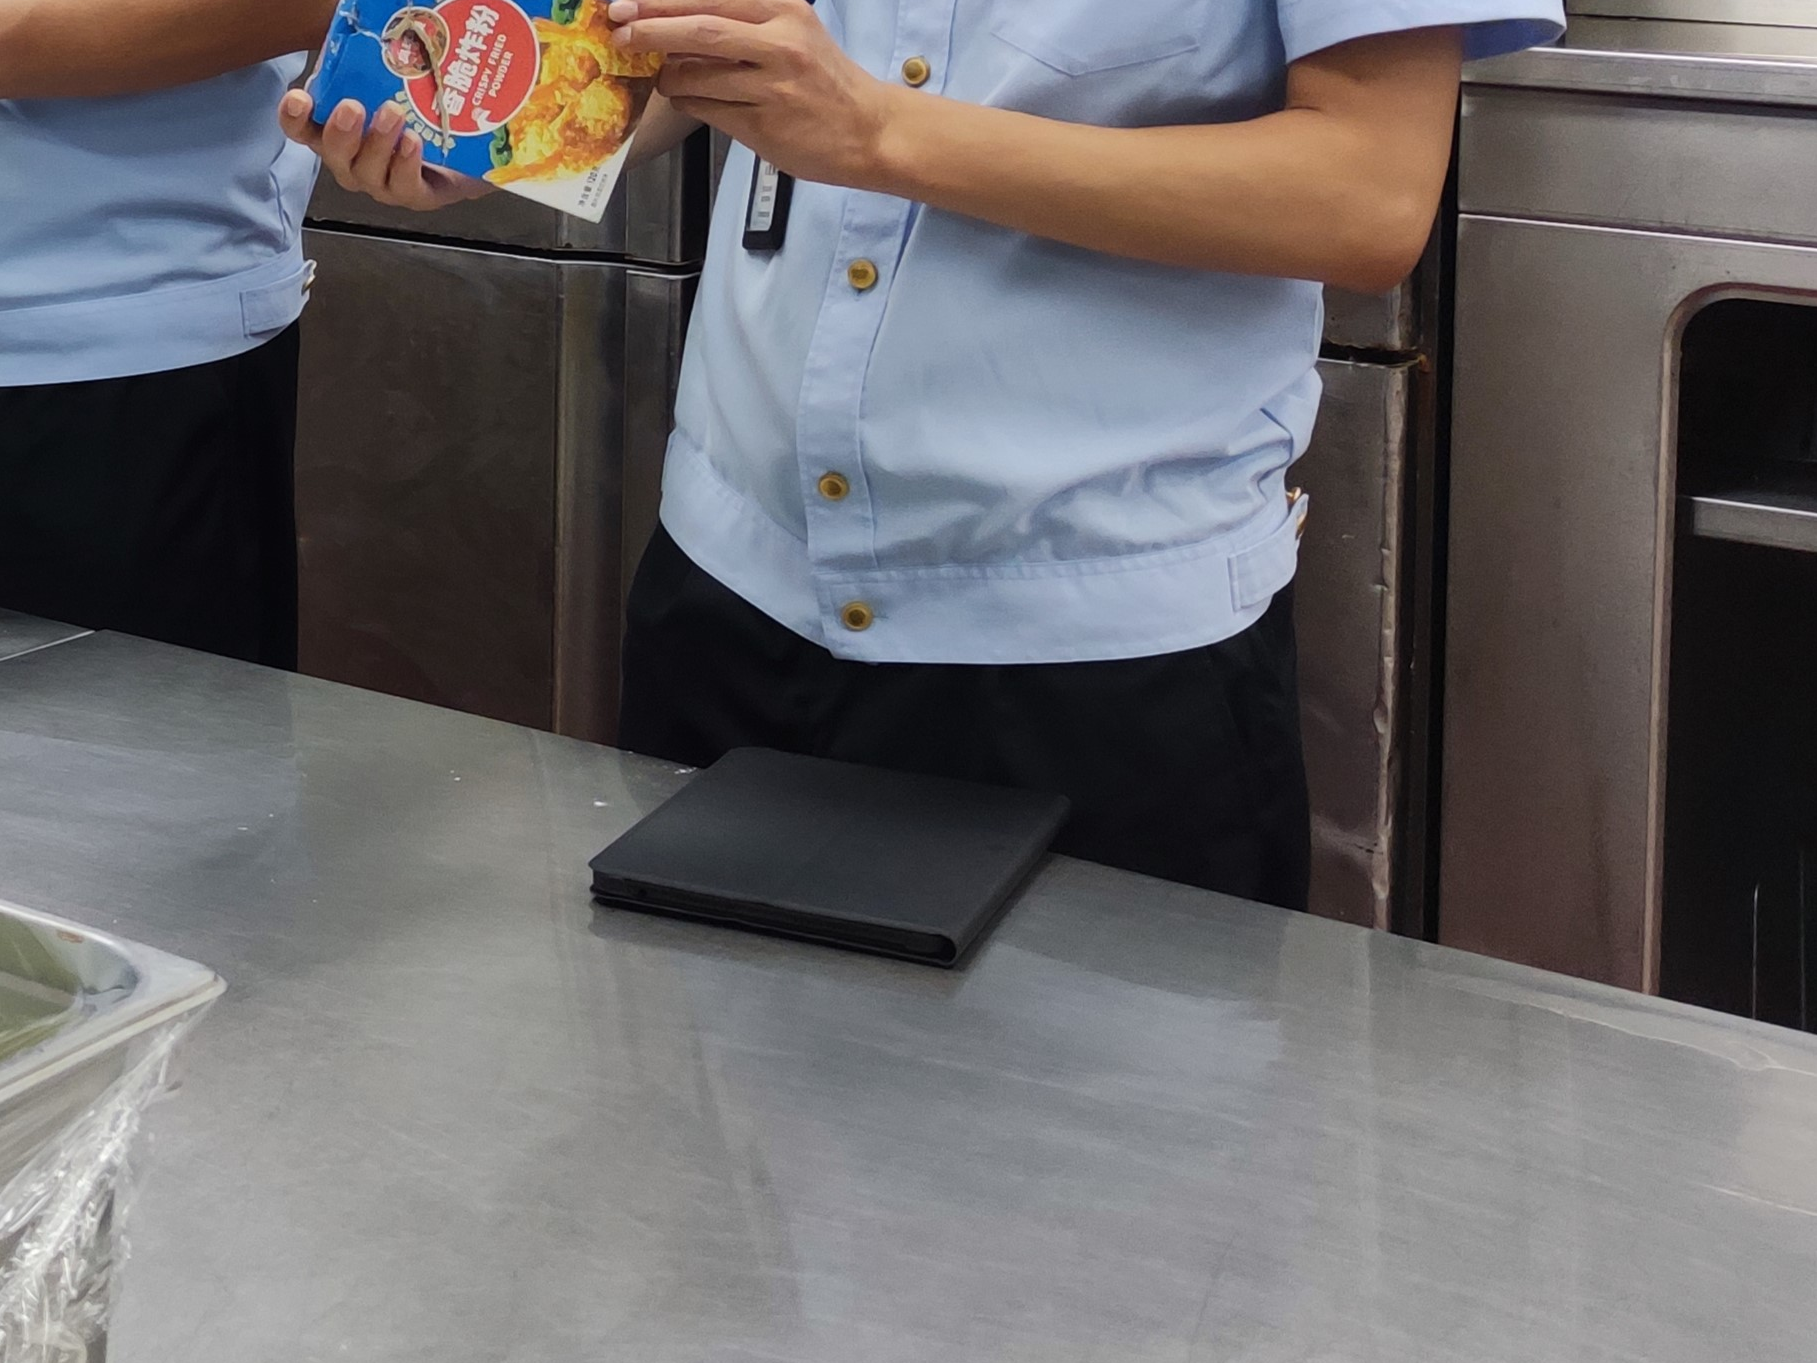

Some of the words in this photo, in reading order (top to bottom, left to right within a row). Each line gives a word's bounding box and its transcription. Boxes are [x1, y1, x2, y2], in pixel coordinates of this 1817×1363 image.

[471, 64, 493, 107] CRISPY
[487, 33, 508, 67] FRIED
[488, 50, 515, 99] POWDER
